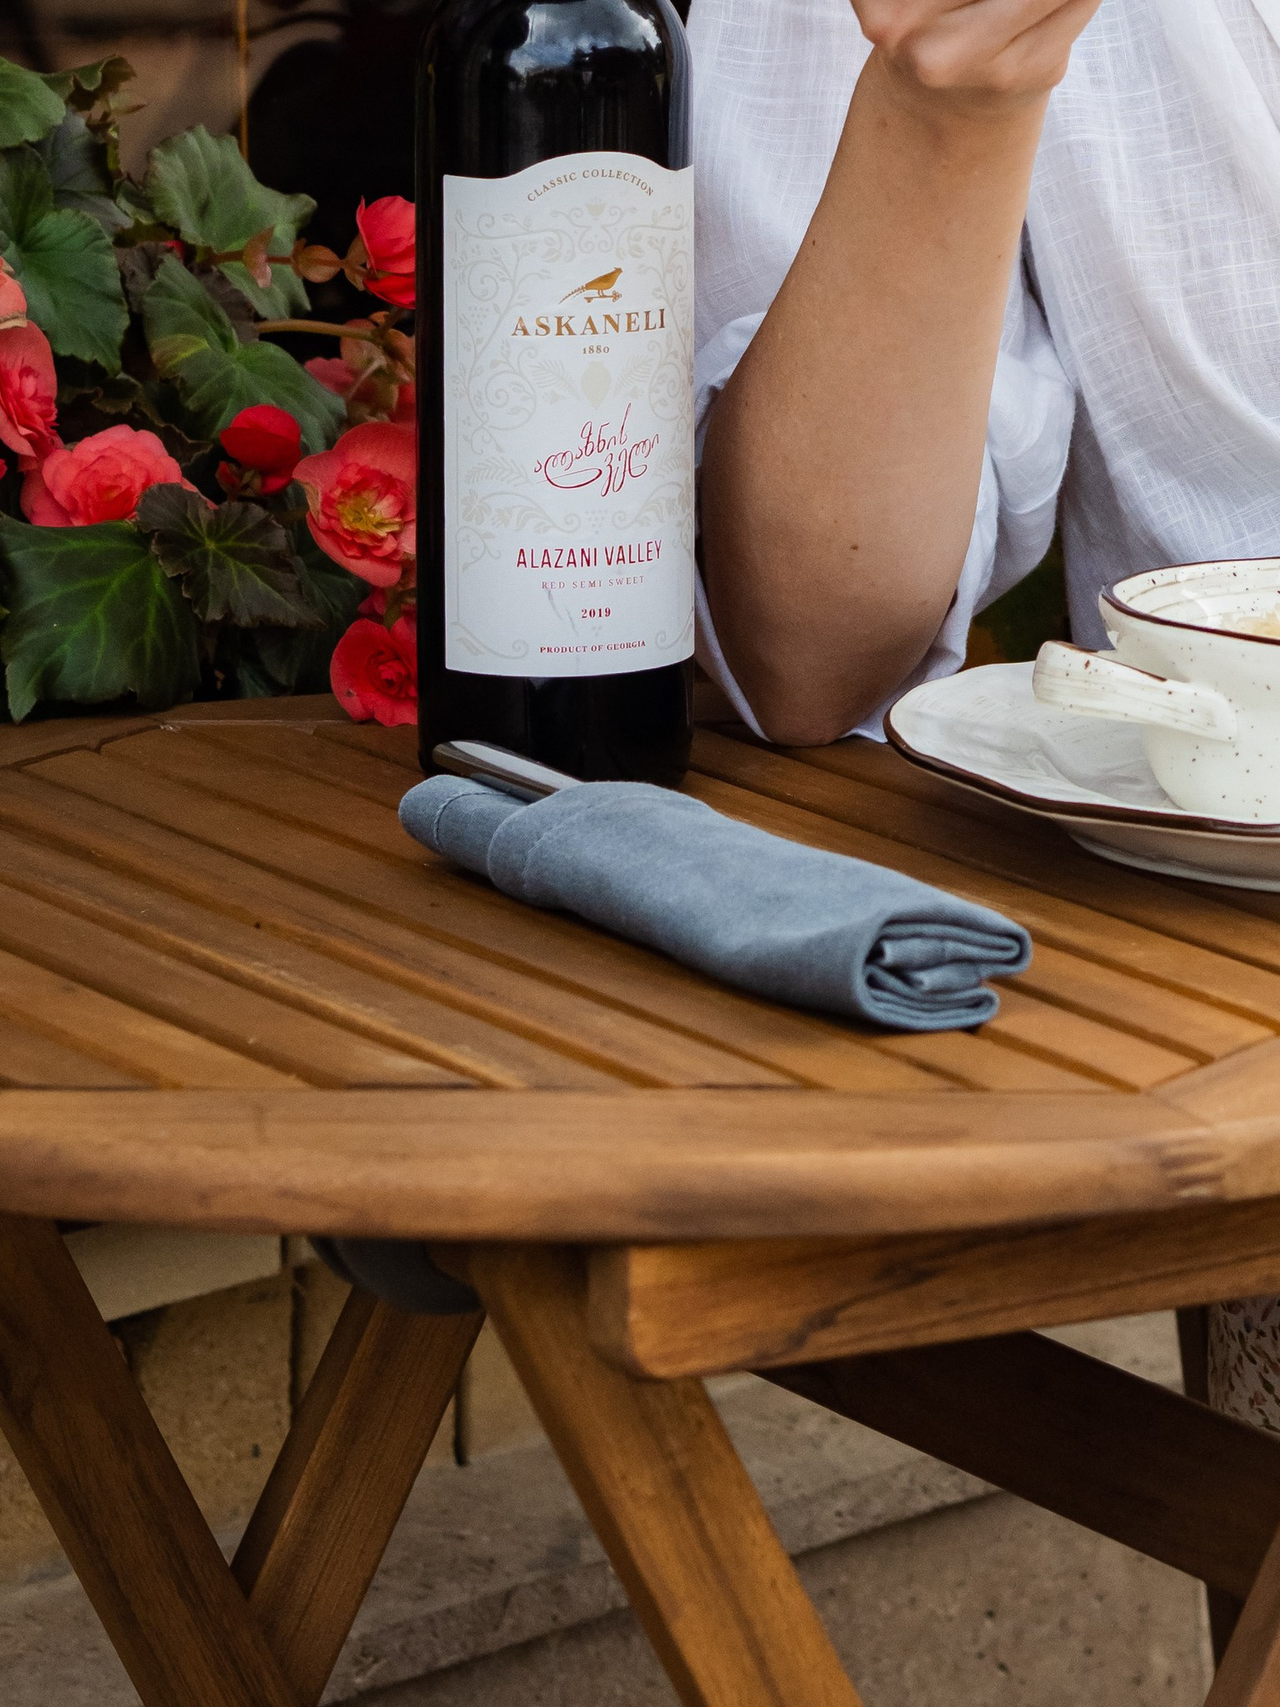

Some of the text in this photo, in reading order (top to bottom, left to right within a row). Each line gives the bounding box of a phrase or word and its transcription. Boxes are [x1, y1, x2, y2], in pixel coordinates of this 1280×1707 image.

[527, 169, 654, 202] CLASSIC COLLECTION
[511, 308, 666, 337] ASKANELI
[582, 345, 610, 354] 1880
[516, 539, 662, 569] ALAZANI VALLEY
[541, 575, 645, 590] RED SEMI SWEET
[581, 607, 611, 619] 2019
[540, 640, 646, 654] PRODUCT OF GEORGIA
